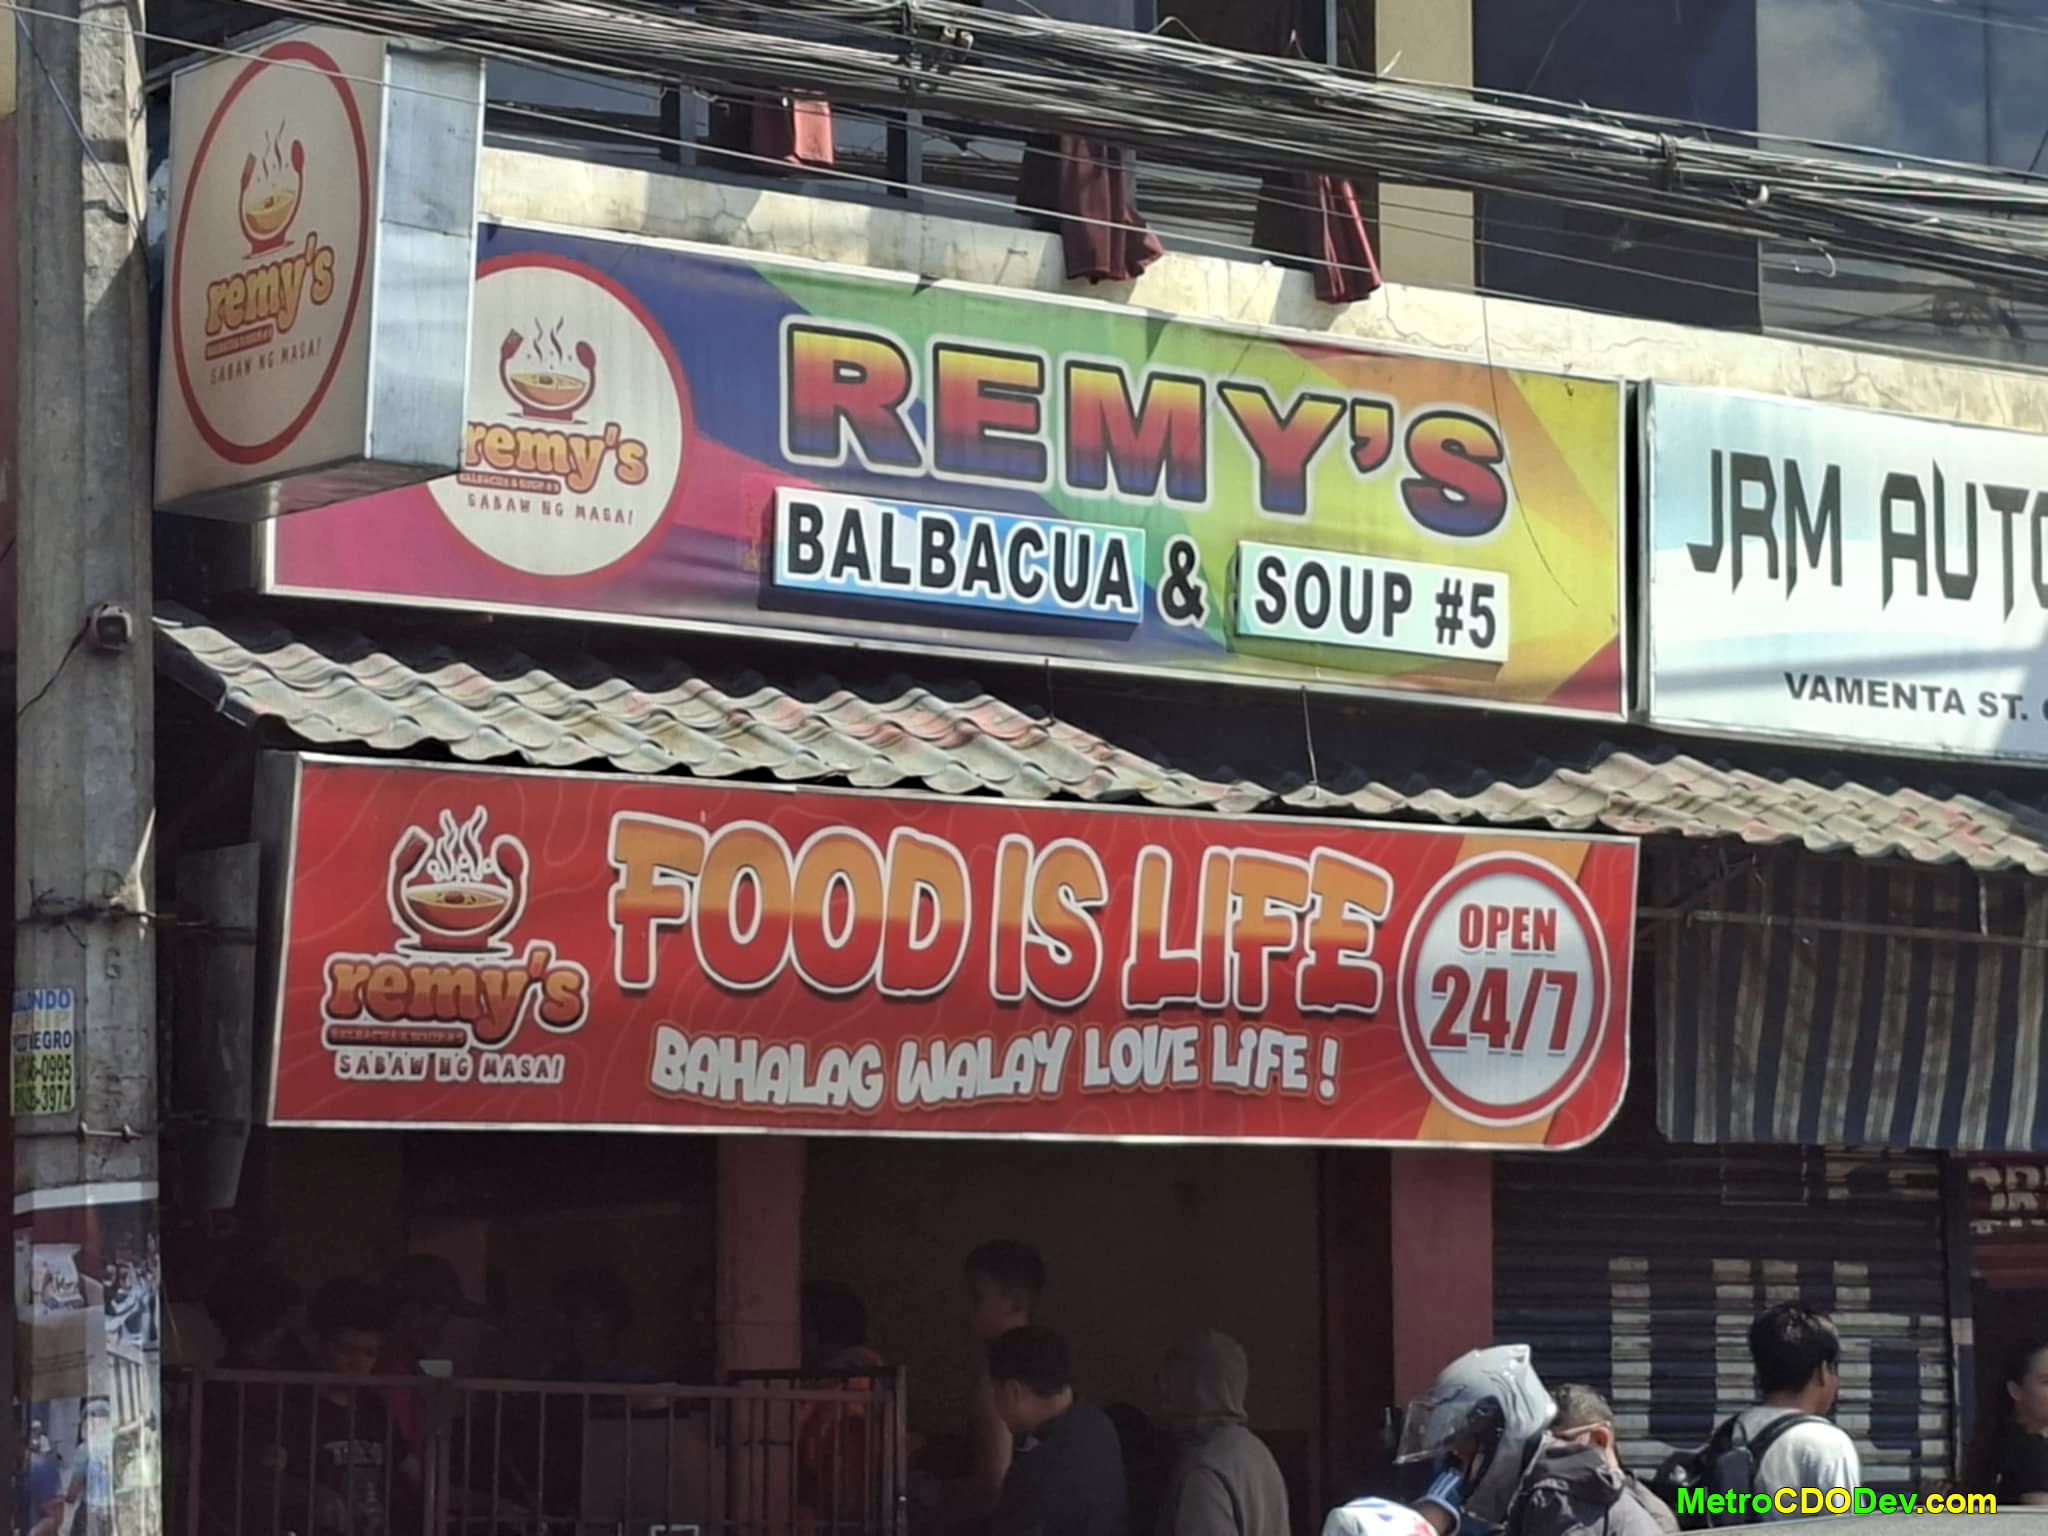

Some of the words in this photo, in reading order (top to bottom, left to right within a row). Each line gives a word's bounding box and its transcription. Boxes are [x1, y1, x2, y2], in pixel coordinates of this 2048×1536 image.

[205, 231, 335, 336] remy's
[465, 421, 649, 494] remy's
[782, 316, 1510, 542] REMY'S
[1686, 449, 1843, 601] JRM
[787, 501, 1134, 609] BALBACUA
[1160, 539, 1205, 622] &
[1255, 555, 1412, 638] SOUP
[1435, 577, 1496, 649] #5
[1784, 672, 1966, 716] VAMENTA
[1978, 691, 2028, 722] ST.
[608, 810, 972, 997] FOOD
[989, 833, 1109, 1008] IS
[1122, 845, 1394, 1013] LIFE
[1458, 903, 1557, 952] OPEN
[323, 942, 587, 1047] remy's
[1430, 964, 1578, 1052] 24/7
[339, 1055, 425, 1076] SABAW
[438, 1057, 470, 1077] NG
[650, 1025, 884, 1109] BAHALAG
[896, 1026, 1073, 1103] WALAY
[1083, 1025, 1199, 1088] LOVE
